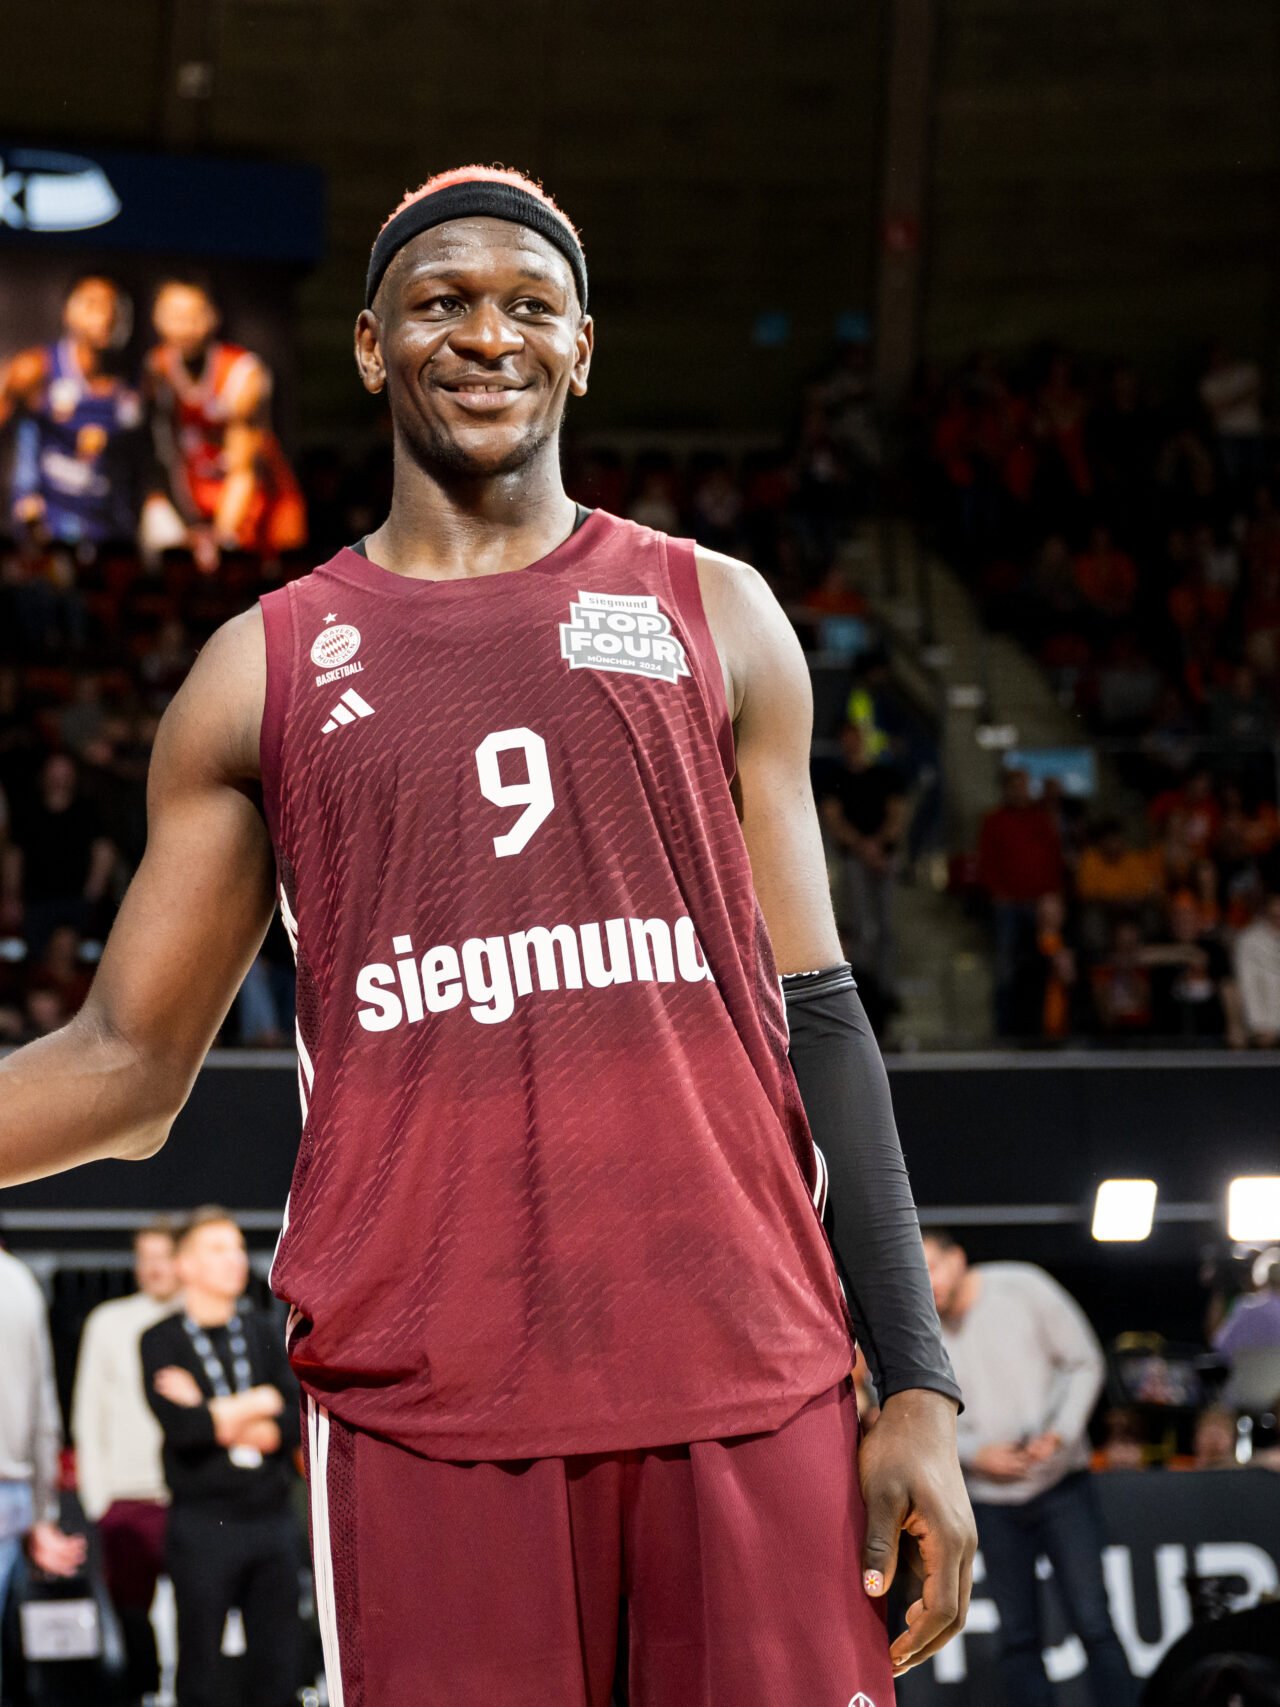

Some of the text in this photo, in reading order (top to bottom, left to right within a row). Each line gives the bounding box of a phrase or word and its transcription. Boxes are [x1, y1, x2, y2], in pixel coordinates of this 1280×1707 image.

[588, 597, 648, 609] siegmund
[580, 610, 662, 635] TOP
[570, 632, 677, 664] FOUR
[315, 661, 364, 687] BASKETBALL
[587, 655, 661, 671] MÜNCHEN 2024
[475, 727, 555, 858] 9
